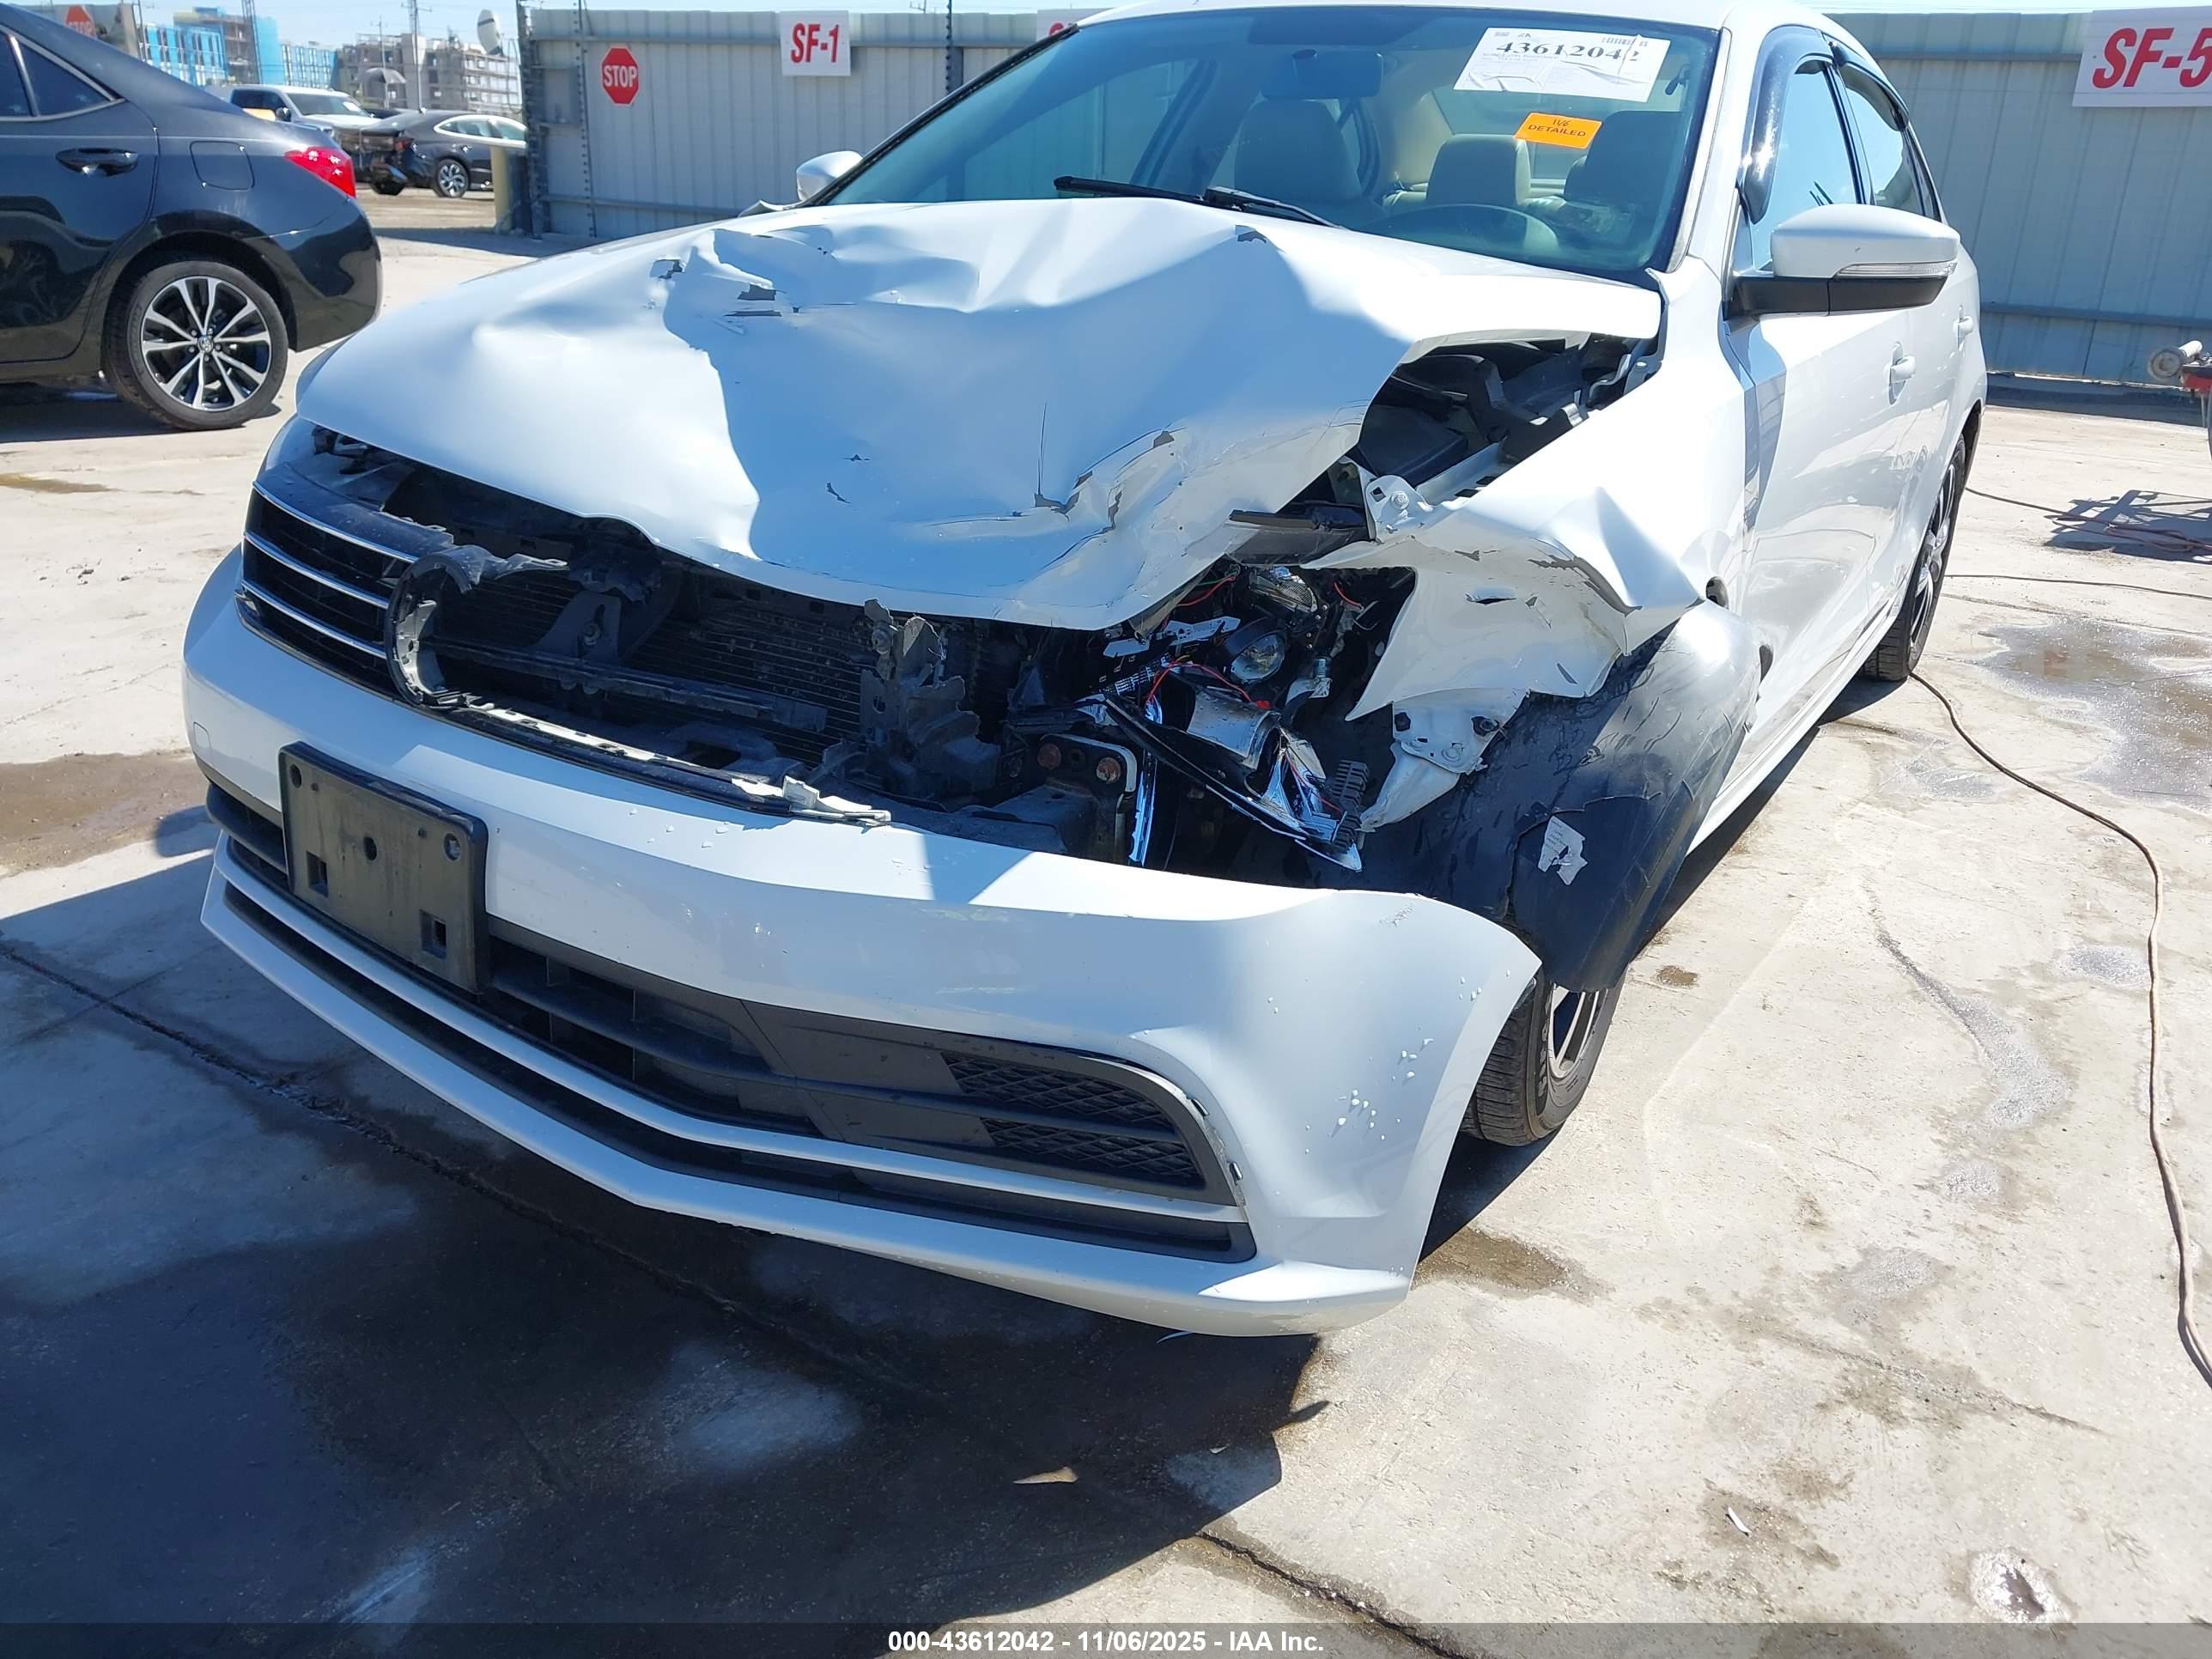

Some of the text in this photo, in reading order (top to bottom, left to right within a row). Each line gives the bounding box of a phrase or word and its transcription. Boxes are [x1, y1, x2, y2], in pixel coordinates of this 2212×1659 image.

[791, 22, 840, 64] SF-1
[2092, 27, 2212, 89] SF-5
[604, 64, 638, 88] STOP
[1528, 124, 1586, 137] DETAILED
